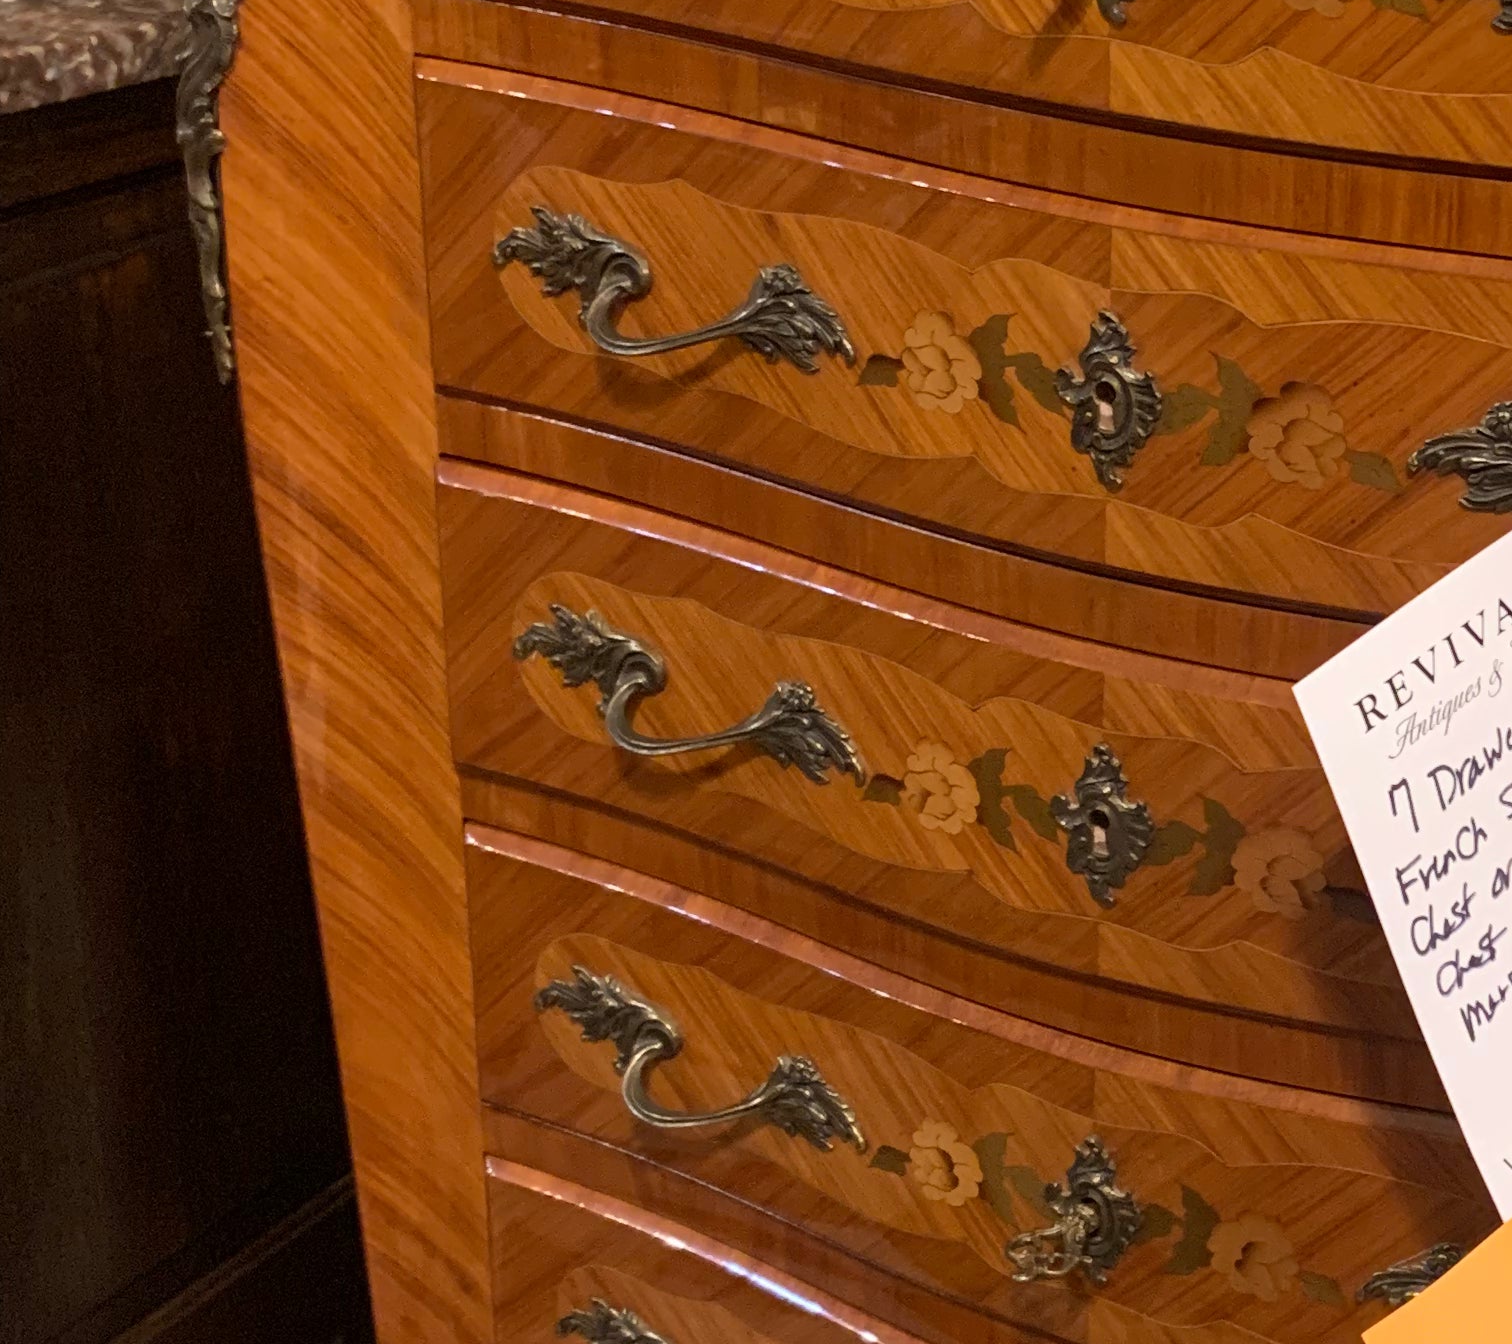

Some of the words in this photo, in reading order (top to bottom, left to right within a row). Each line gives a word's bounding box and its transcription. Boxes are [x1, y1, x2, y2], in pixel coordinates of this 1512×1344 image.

[1388, 675, 1481, 759] Antiques
[1488, 658, 1502, 696] &
[1388, 777, 1420, 832] 7
[1396, 817, 1488, 905] French
[1410, 882, 1476, 956] Chest
